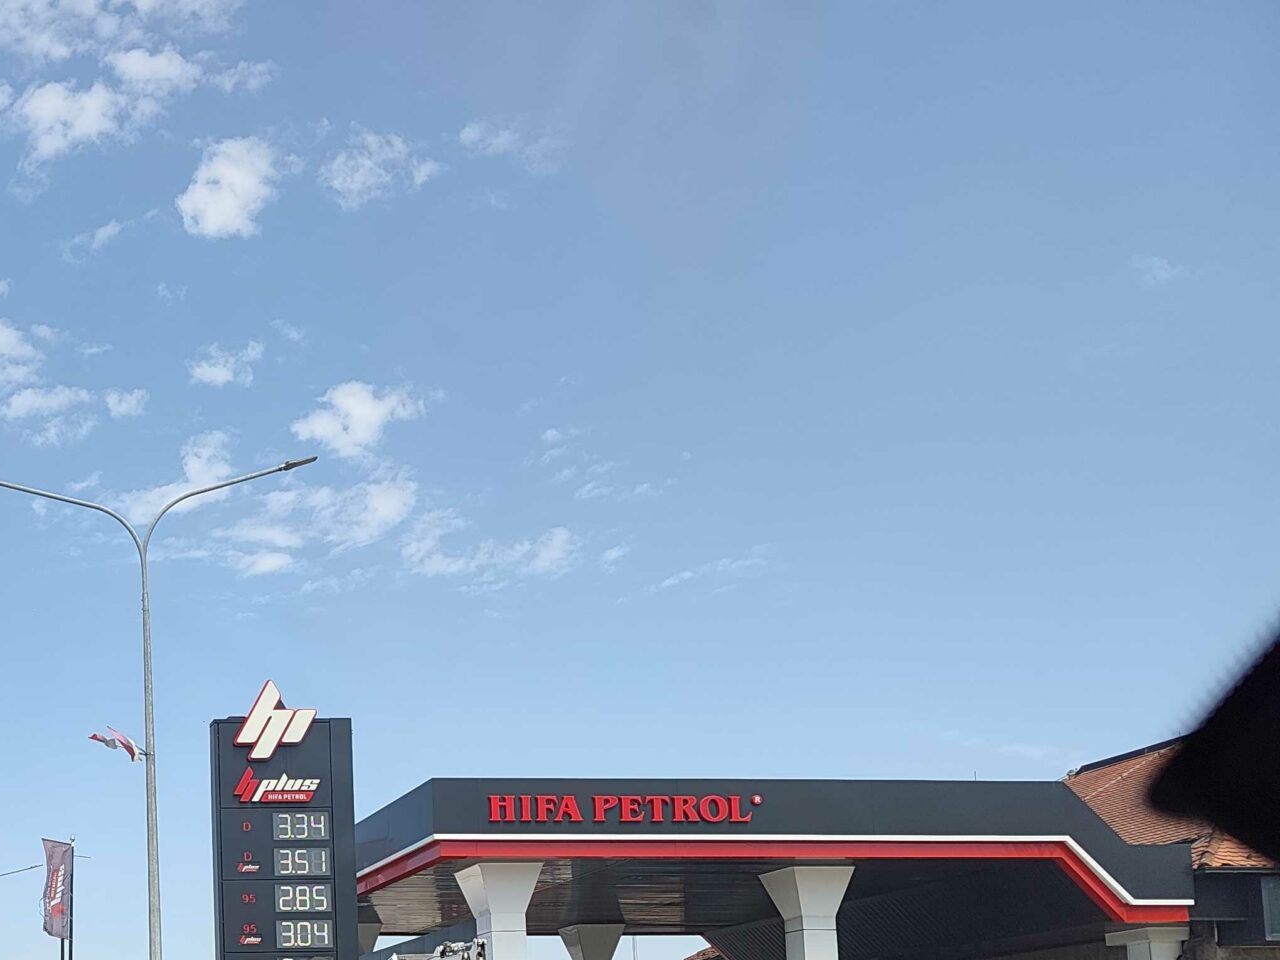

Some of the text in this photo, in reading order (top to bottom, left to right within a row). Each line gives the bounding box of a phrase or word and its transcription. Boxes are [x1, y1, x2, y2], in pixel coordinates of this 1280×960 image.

[488, 794, 584, 822] HIFA
[592, 794, 754, 822] PETROL
[243, 823, 252, 831] D
[278, 814, 325, 838] 3.34
[244, 852, 252, 861] D
[280, 850, 326, 874] 3.51
[241, 894, 256, 903] 95
[280, 886, 327, 911] 2.85
[243, 924, 257, 933] 95
[281, 922, 328, 946] 3.04
